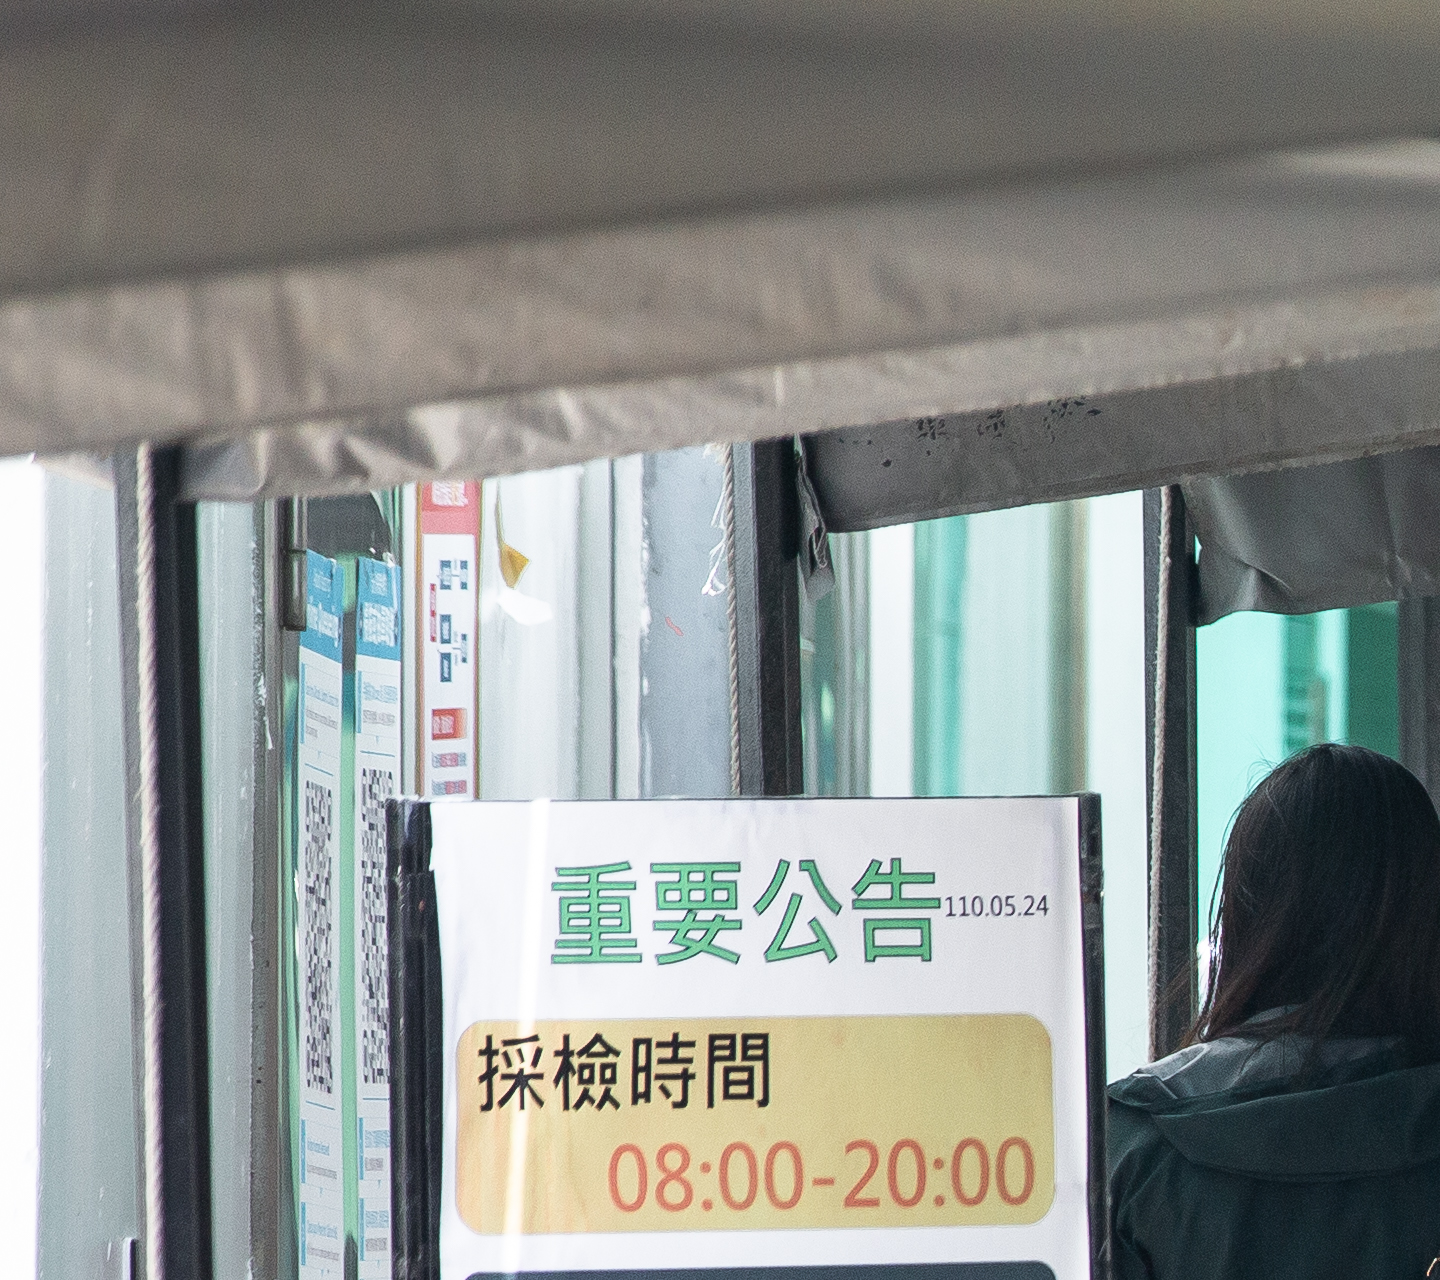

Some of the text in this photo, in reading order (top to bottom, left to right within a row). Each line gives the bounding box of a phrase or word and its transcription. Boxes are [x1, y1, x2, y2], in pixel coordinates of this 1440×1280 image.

[550, 857, 1050, 966] 重要公告 110.05.24
[477, 1031, 771, 1113] 採檢時間
[607, 1135, 1036, 1213] 08:00-20:00
